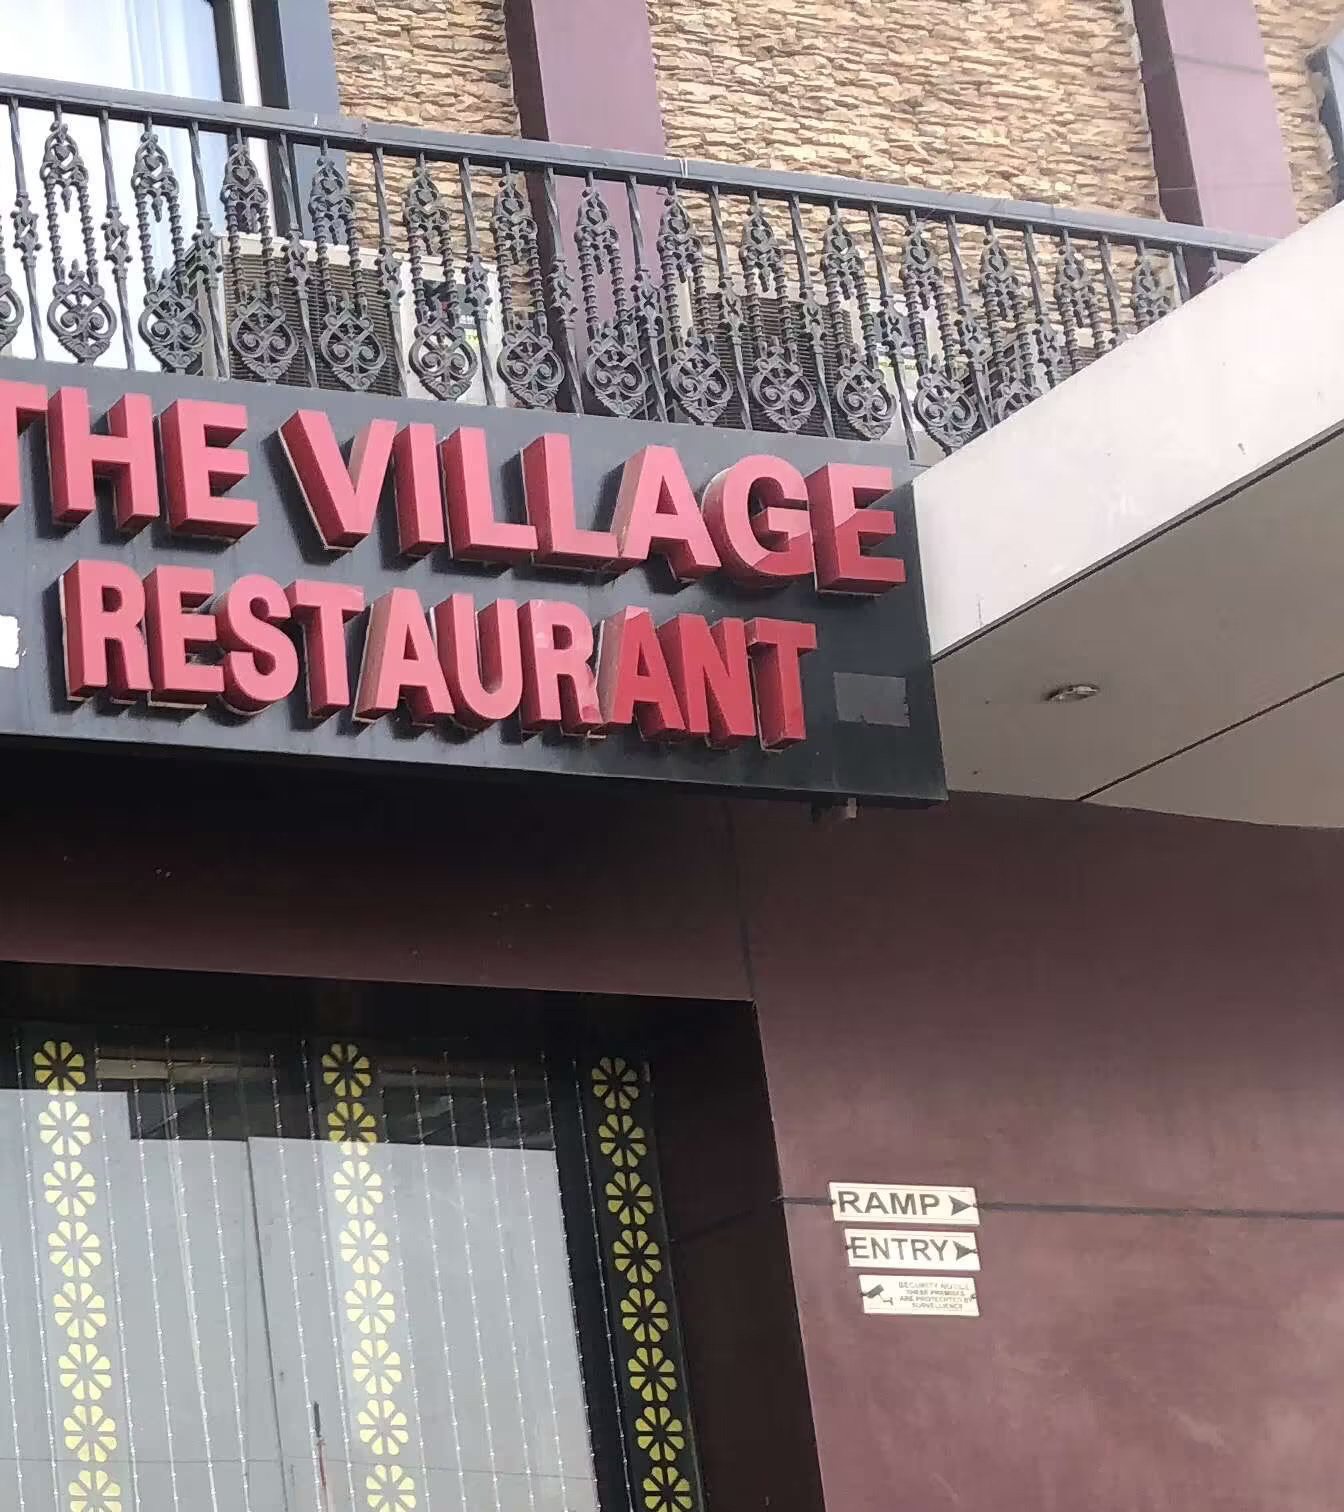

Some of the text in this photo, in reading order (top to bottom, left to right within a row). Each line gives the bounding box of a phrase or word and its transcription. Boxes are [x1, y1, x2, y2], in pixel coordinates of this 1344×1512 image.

[278, 408, 907, 596] VILLAGE
[61, 559, 817, 752] RESTAURANT
[837, 1190, 941, 1216] RAMP
[850, 1236, 949, 1261] ENTRY
